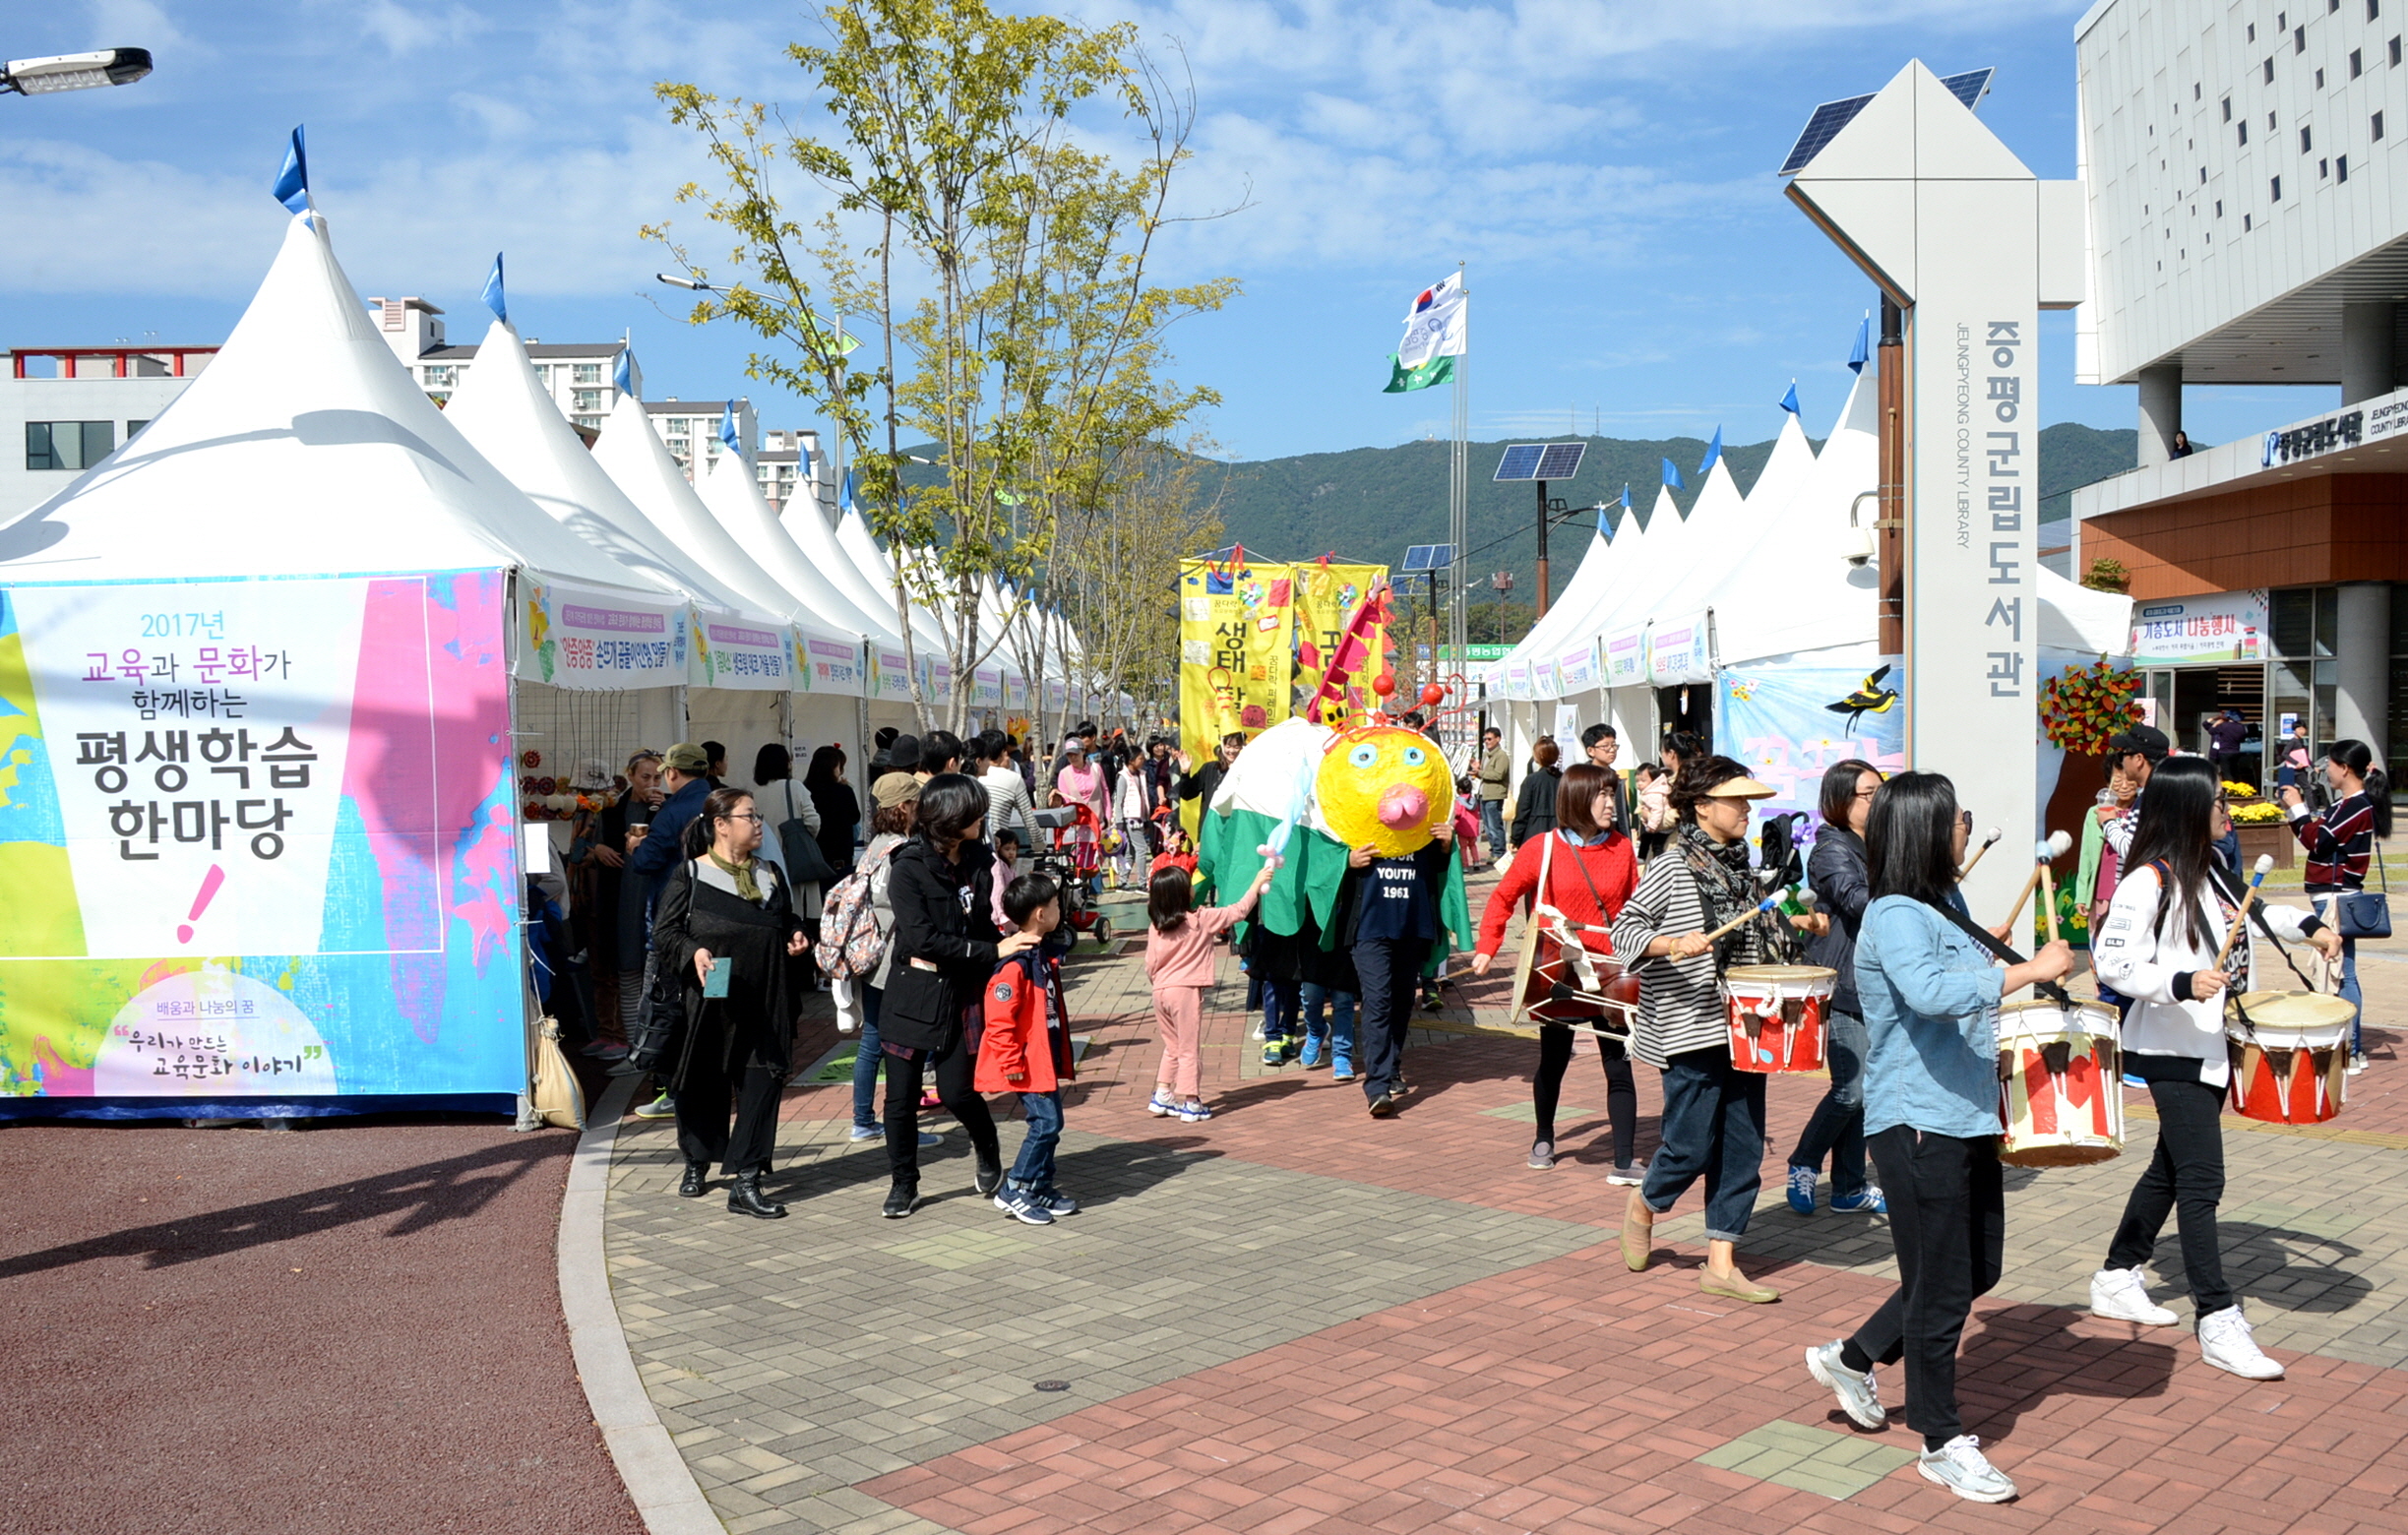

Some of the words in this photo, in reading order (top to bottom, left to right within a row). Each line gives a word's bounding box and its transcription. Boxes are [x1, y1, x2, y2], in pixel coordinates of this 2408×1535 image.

[1956, 322, 1970, 424] JEUNGPYEONG
[2280, 409, 2364, 460] 증평군립도서관
[2370, 420, 2393, 436] COUNTY
[1956, 427, 1970, 488] COUNTY
[1956, 491, 1970, 549] LIBRARY
[1985, 321, 2024, 697] 증평군립도서관
[140, 609, 225, 641] 2017년
[2143, 619, 2184, 640] 기증도서
[2187, 613, 2236, 638] 나눔행사
[82, 647, 180, 687] 교육과
[193, 644, 292, 684] 문화가
[1215, 622, 1248, 673] 생태
[132, 688, 248, 720] 함께하는
[76, 726, 318, 794] 평생학습
[108, 798, 293, 861] 한마당
[1377, 867, 1417, 881] YOUTH
[1383, 887, 1410, 898] 1961
[156, 1002, 196, 1015] 배움과
[199, 1000, 238, 1014] 나눔의
[241, 1000, 255, 1013] 꿈
[188, 1034, 228, 1053] 만드는
[153, 1054, 233, 1080] 교육문화
